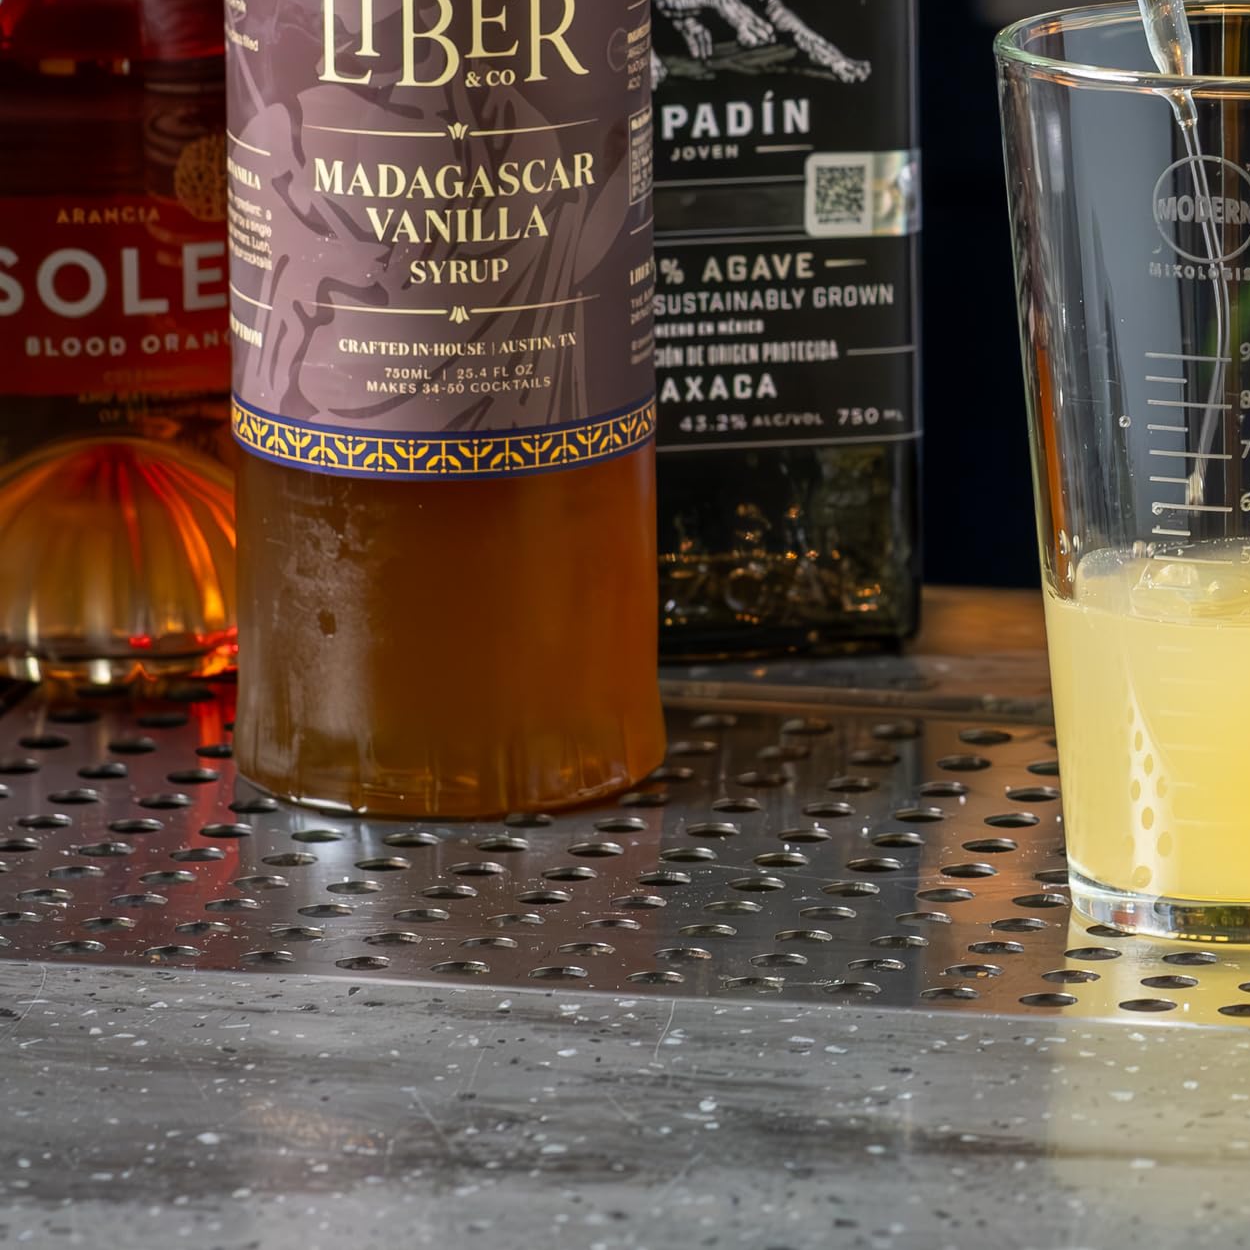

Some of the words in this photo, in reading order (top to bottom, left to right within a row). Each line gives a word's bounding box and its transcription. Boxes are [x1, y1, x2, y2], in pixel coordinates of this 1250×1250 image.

[465, 70, 482, 88] &
[486, 69, 516, 88] CO
[662, 91, 810, 139] PADÍN
[670, 145, 739, 161] JOVEN
[314, 152, 597, 199] MADAGASCAR
[56, 206, 161, 225] ARANCIA
[366, 206, 549, 243] VANILLA
[0, 241, 227, 318] SOLE
[410, 258, 510, 286] SYRUP
[702, 252, 815, 283] AGAVE
[652, 288, 805, 316] SUSTAINABLY
[813, 284, 895, 309] GROWN
[25, 335, 126, 357] BLOOD
[338, 338, 410, 356] CRAFTED
[413, 342, 486, 357] IN-HOUSE
[558, 332, 577, 347] TX
[686, 345, 704, 367] DE
[384, 366, 432, 380] 750ML
[456, 366, 488, 380] 25.4
[493, 365, 509, 378] FL
[514, 363, 534, 376] OZ
[366, 380, 417, 394] MAKES
[422, 381, 465, 394] 34-50
[470, 376, 552, 394] COCKTAILS
[660, 373, 778, 403] AXACA
[836, 406, 880, 426] 750
